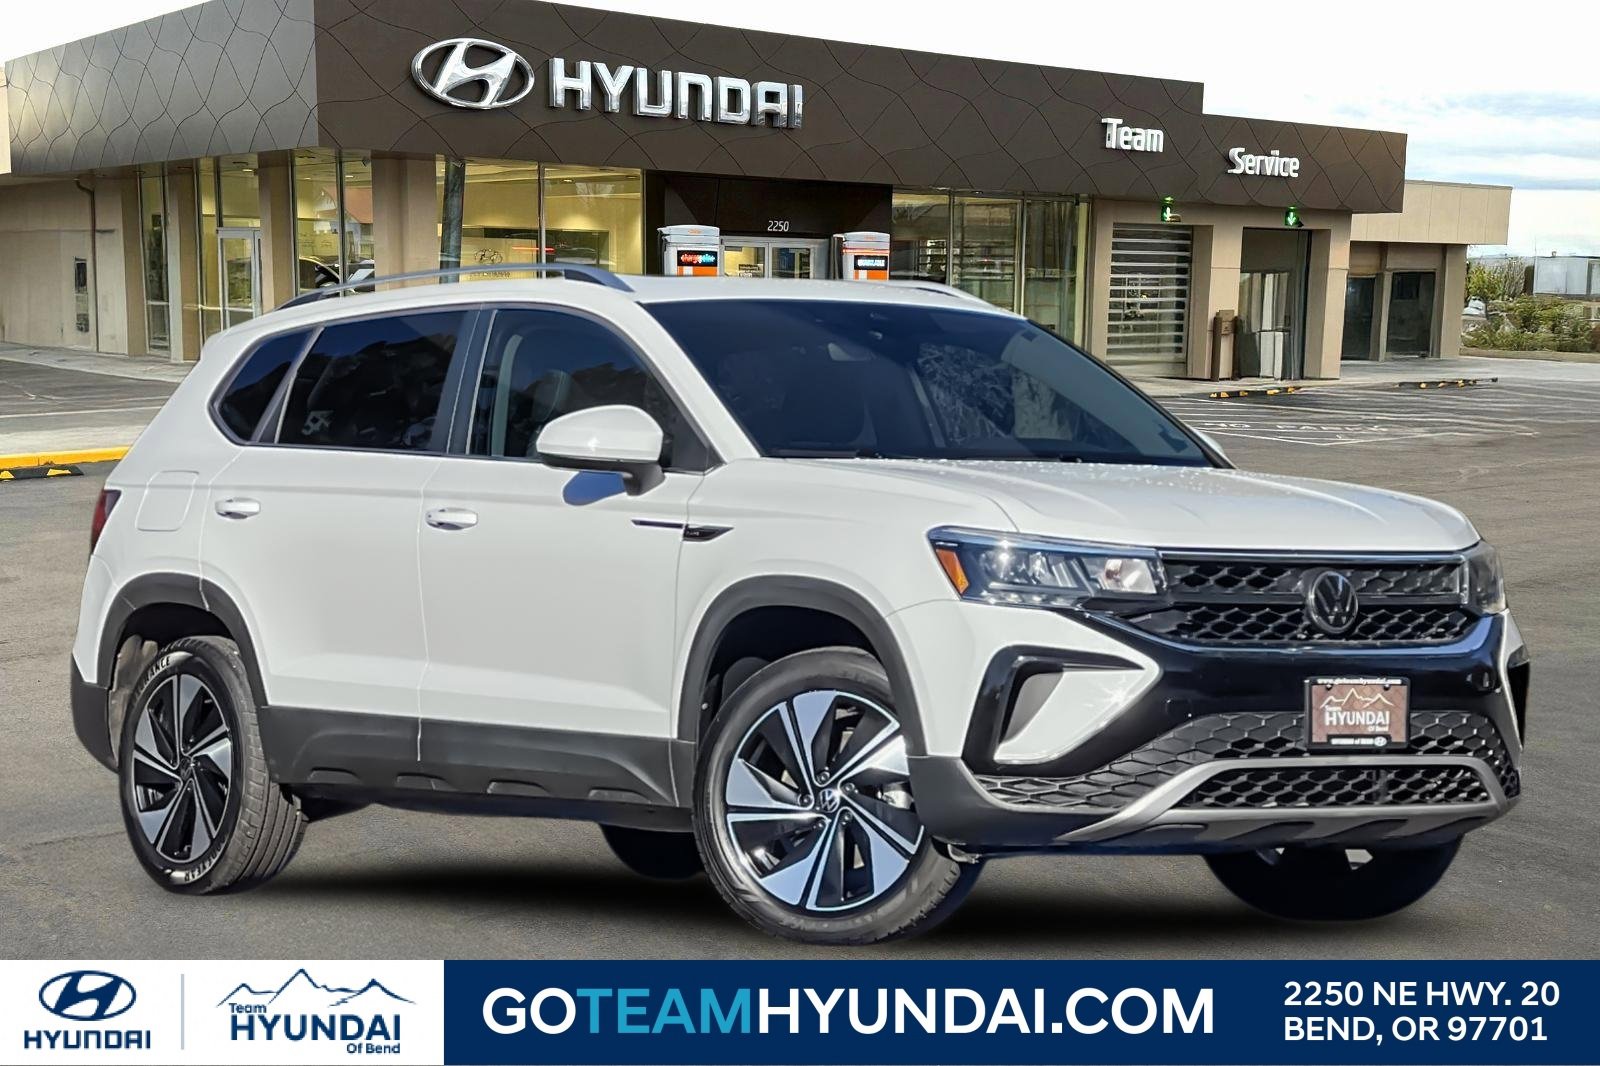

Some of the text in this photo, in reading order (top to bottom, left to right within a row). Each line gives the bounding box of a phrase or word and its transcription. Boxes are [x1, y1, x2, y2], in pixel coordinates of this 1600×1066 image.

[548, 57, 804, 129] HYUNDAI
[1101, 117, 1164, 152] Team
[1227, 147, 1300, 178] Service
[767, 220, 790, 232] 2250
[1325, 710, 1391, 726] HYUNDAI
